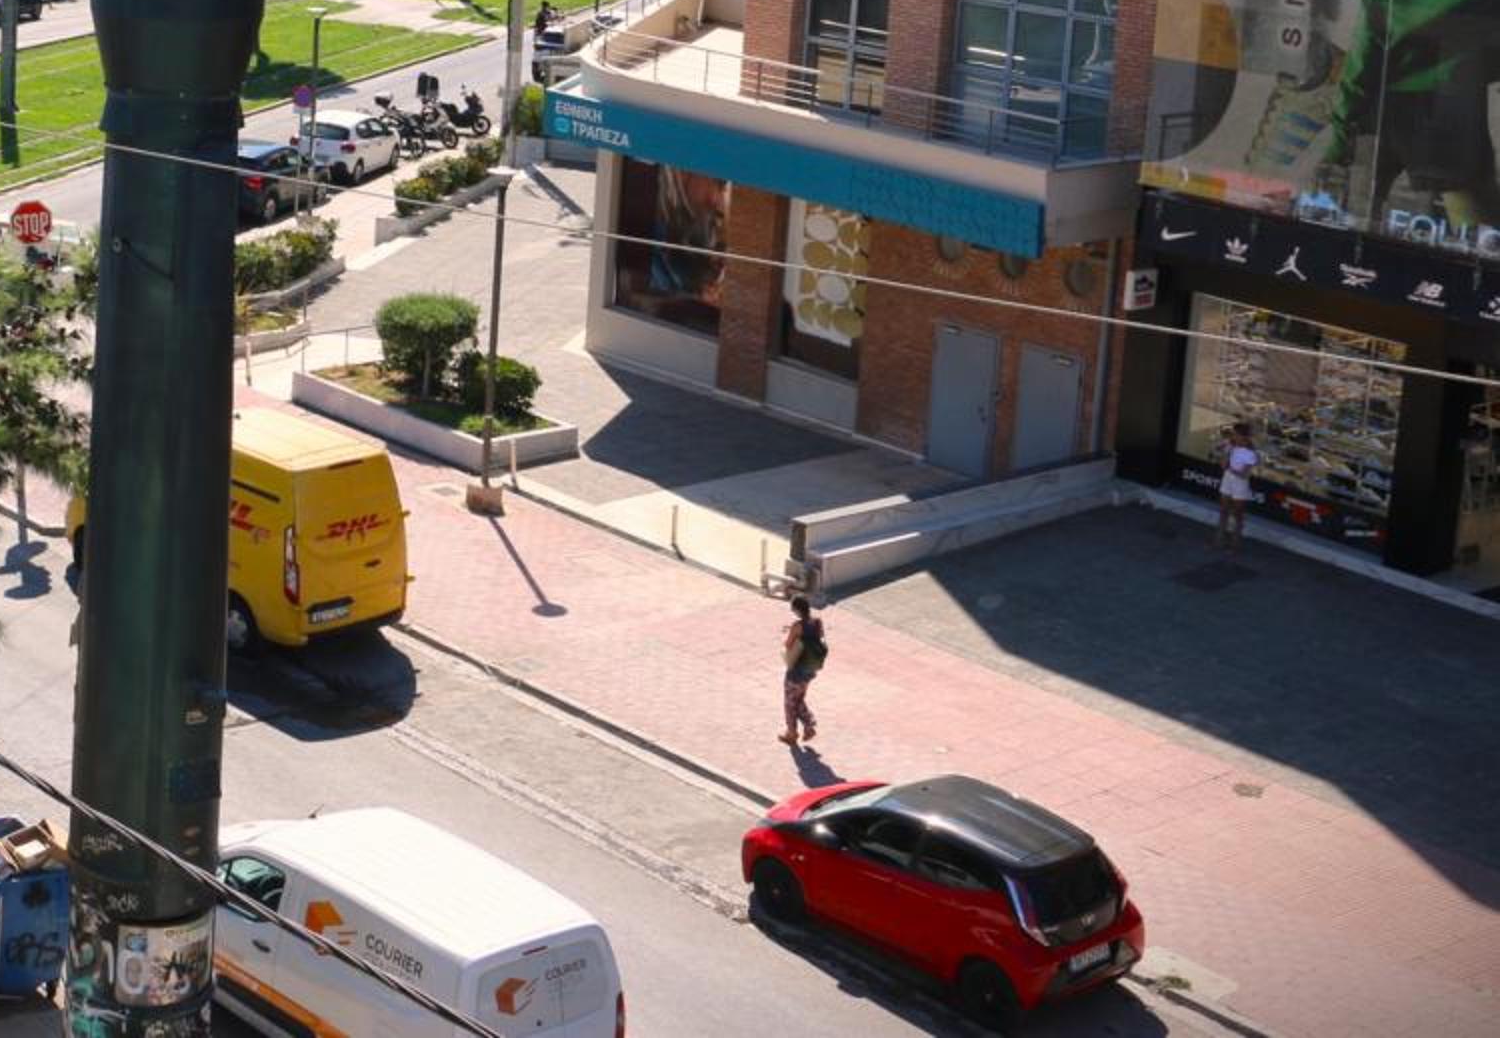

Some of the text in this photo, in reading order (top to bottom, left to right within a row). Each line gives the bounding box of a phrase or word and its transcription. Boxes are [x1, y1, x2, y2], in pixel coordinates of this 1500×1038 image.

[555, 100, 603, 123] ΕΘΝΙΚΗ
[572, 120, 630, 146] ΤΡΑΠΕΖΑ
[13, 211, 49, 236] STOP
[325, 513, 382, 538] DHL
[365, 933, 424, 980] COURIER
[544, 958, 587, 982] COURIER
